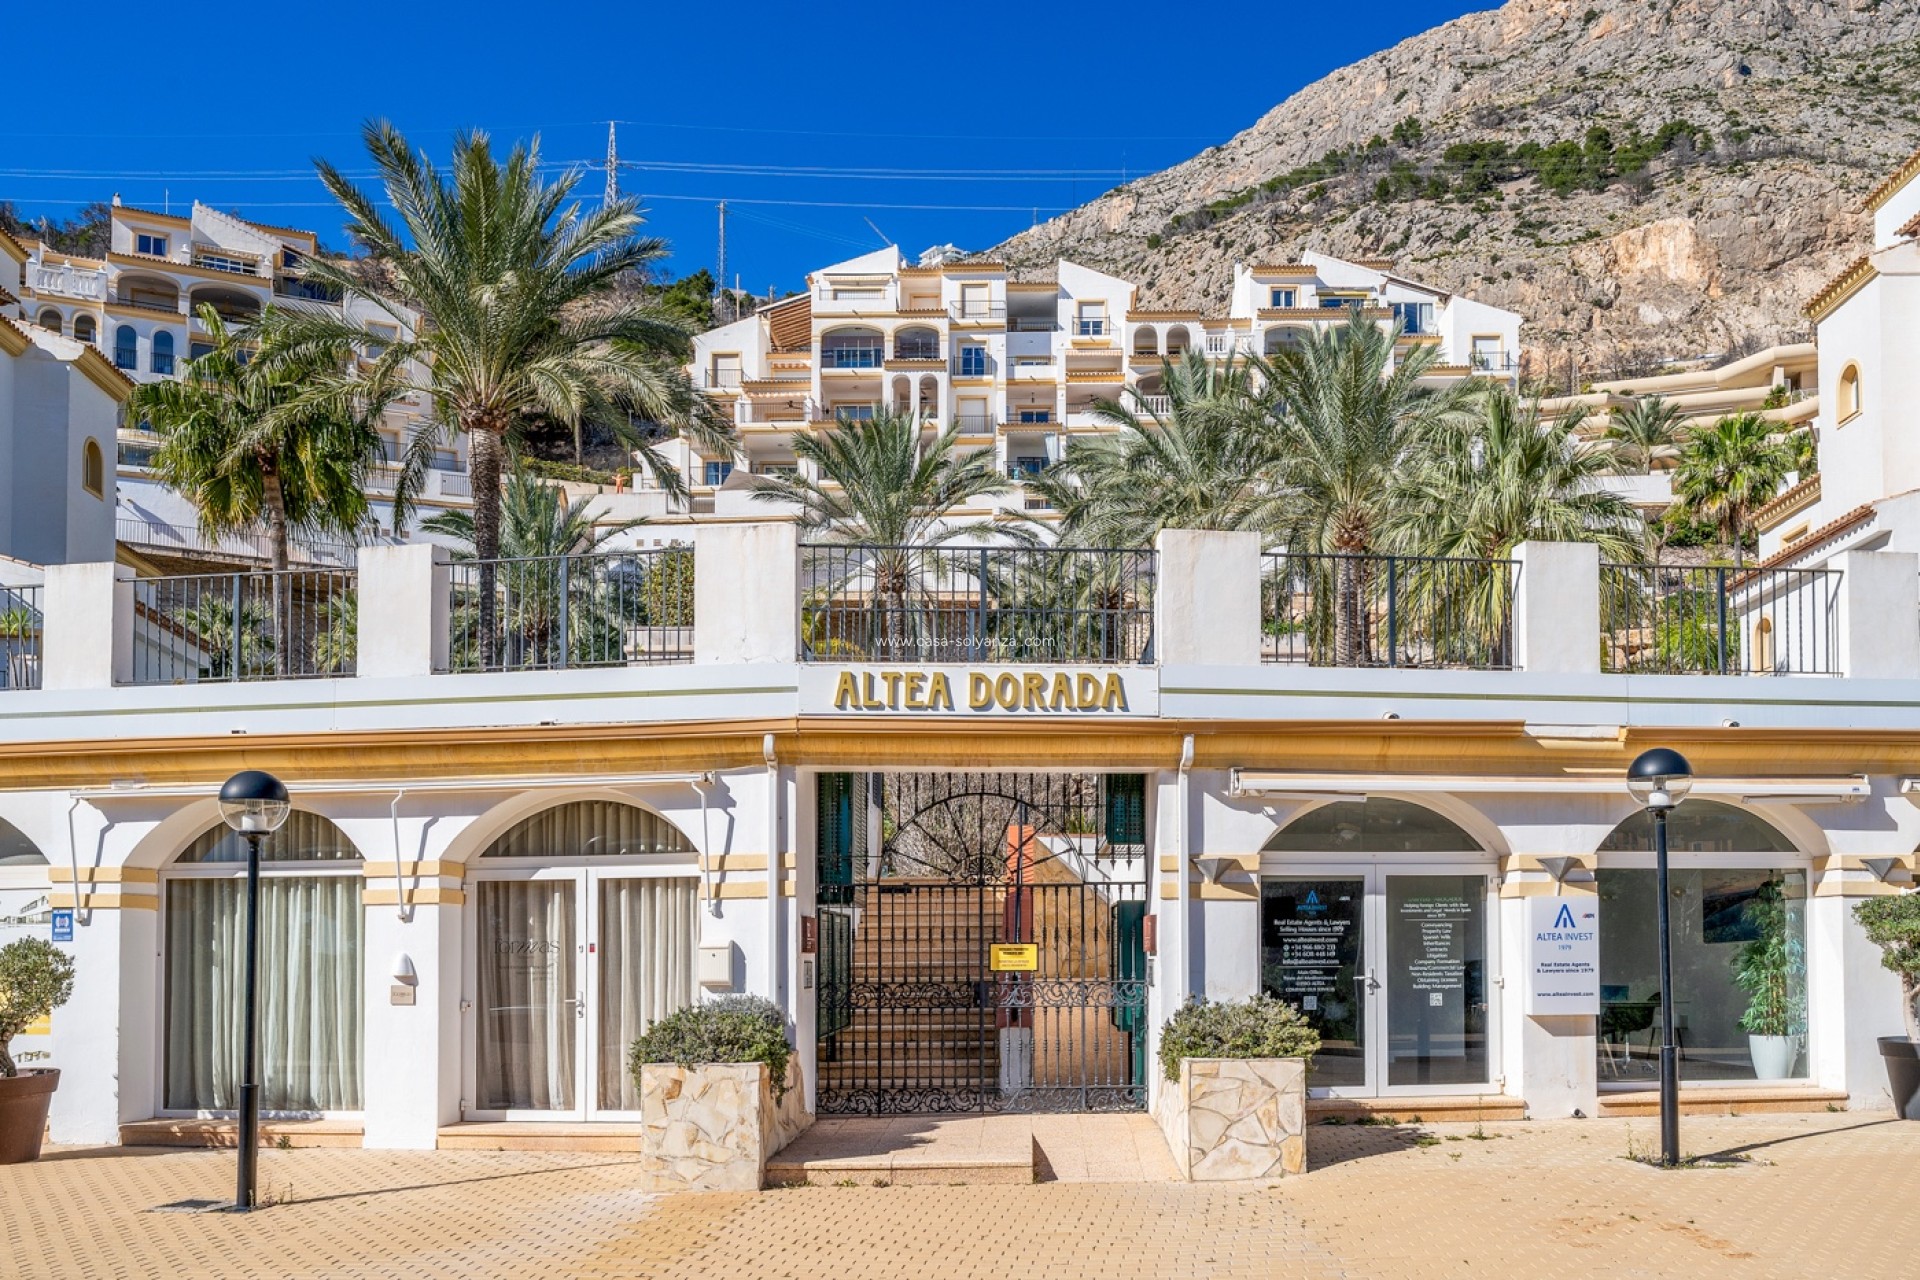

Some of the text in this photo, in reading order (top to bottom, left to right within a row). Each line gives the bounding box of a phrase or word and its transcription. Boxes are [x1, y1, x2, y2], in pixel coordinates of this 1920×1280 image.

[833, 671, 1129, 711] ALTEA DORADA
[1536, 932, 1594, 941] ALTEA INVEST
[494, 937, 561, 954] formas
